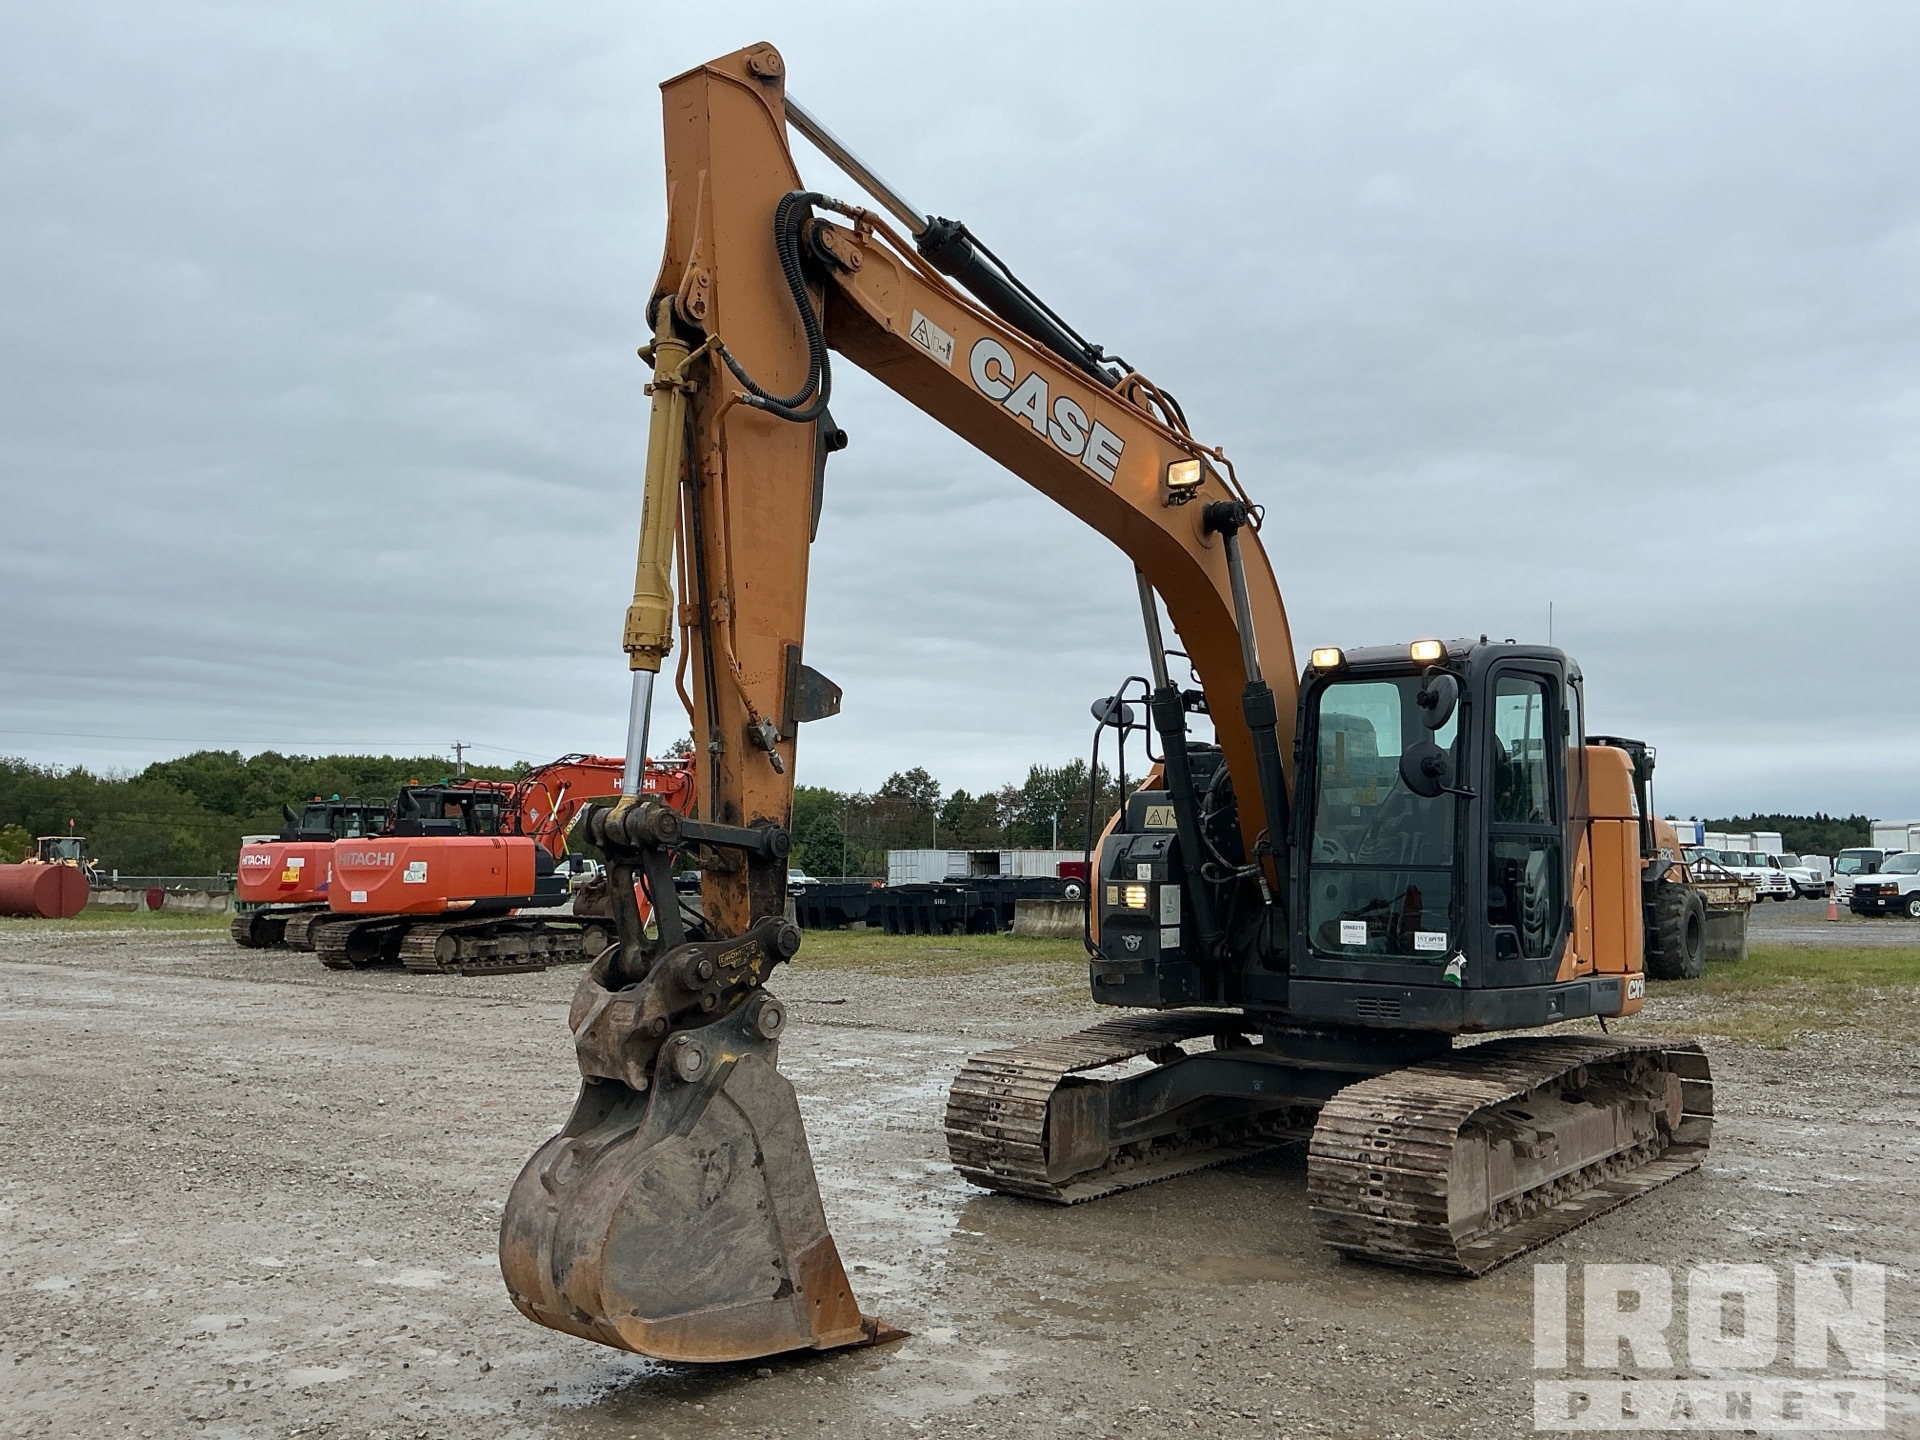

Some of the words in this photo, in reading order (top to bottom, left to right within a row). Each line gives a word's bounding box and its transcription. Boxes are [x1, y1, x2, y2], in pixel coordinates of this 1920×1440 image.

[969, 337, 1126, 485] CASE
[613, 777, 656, 790] HIHI
[241, 854, 271, 866] HITACHI
[338, 852, 395, 866] HITACHI
